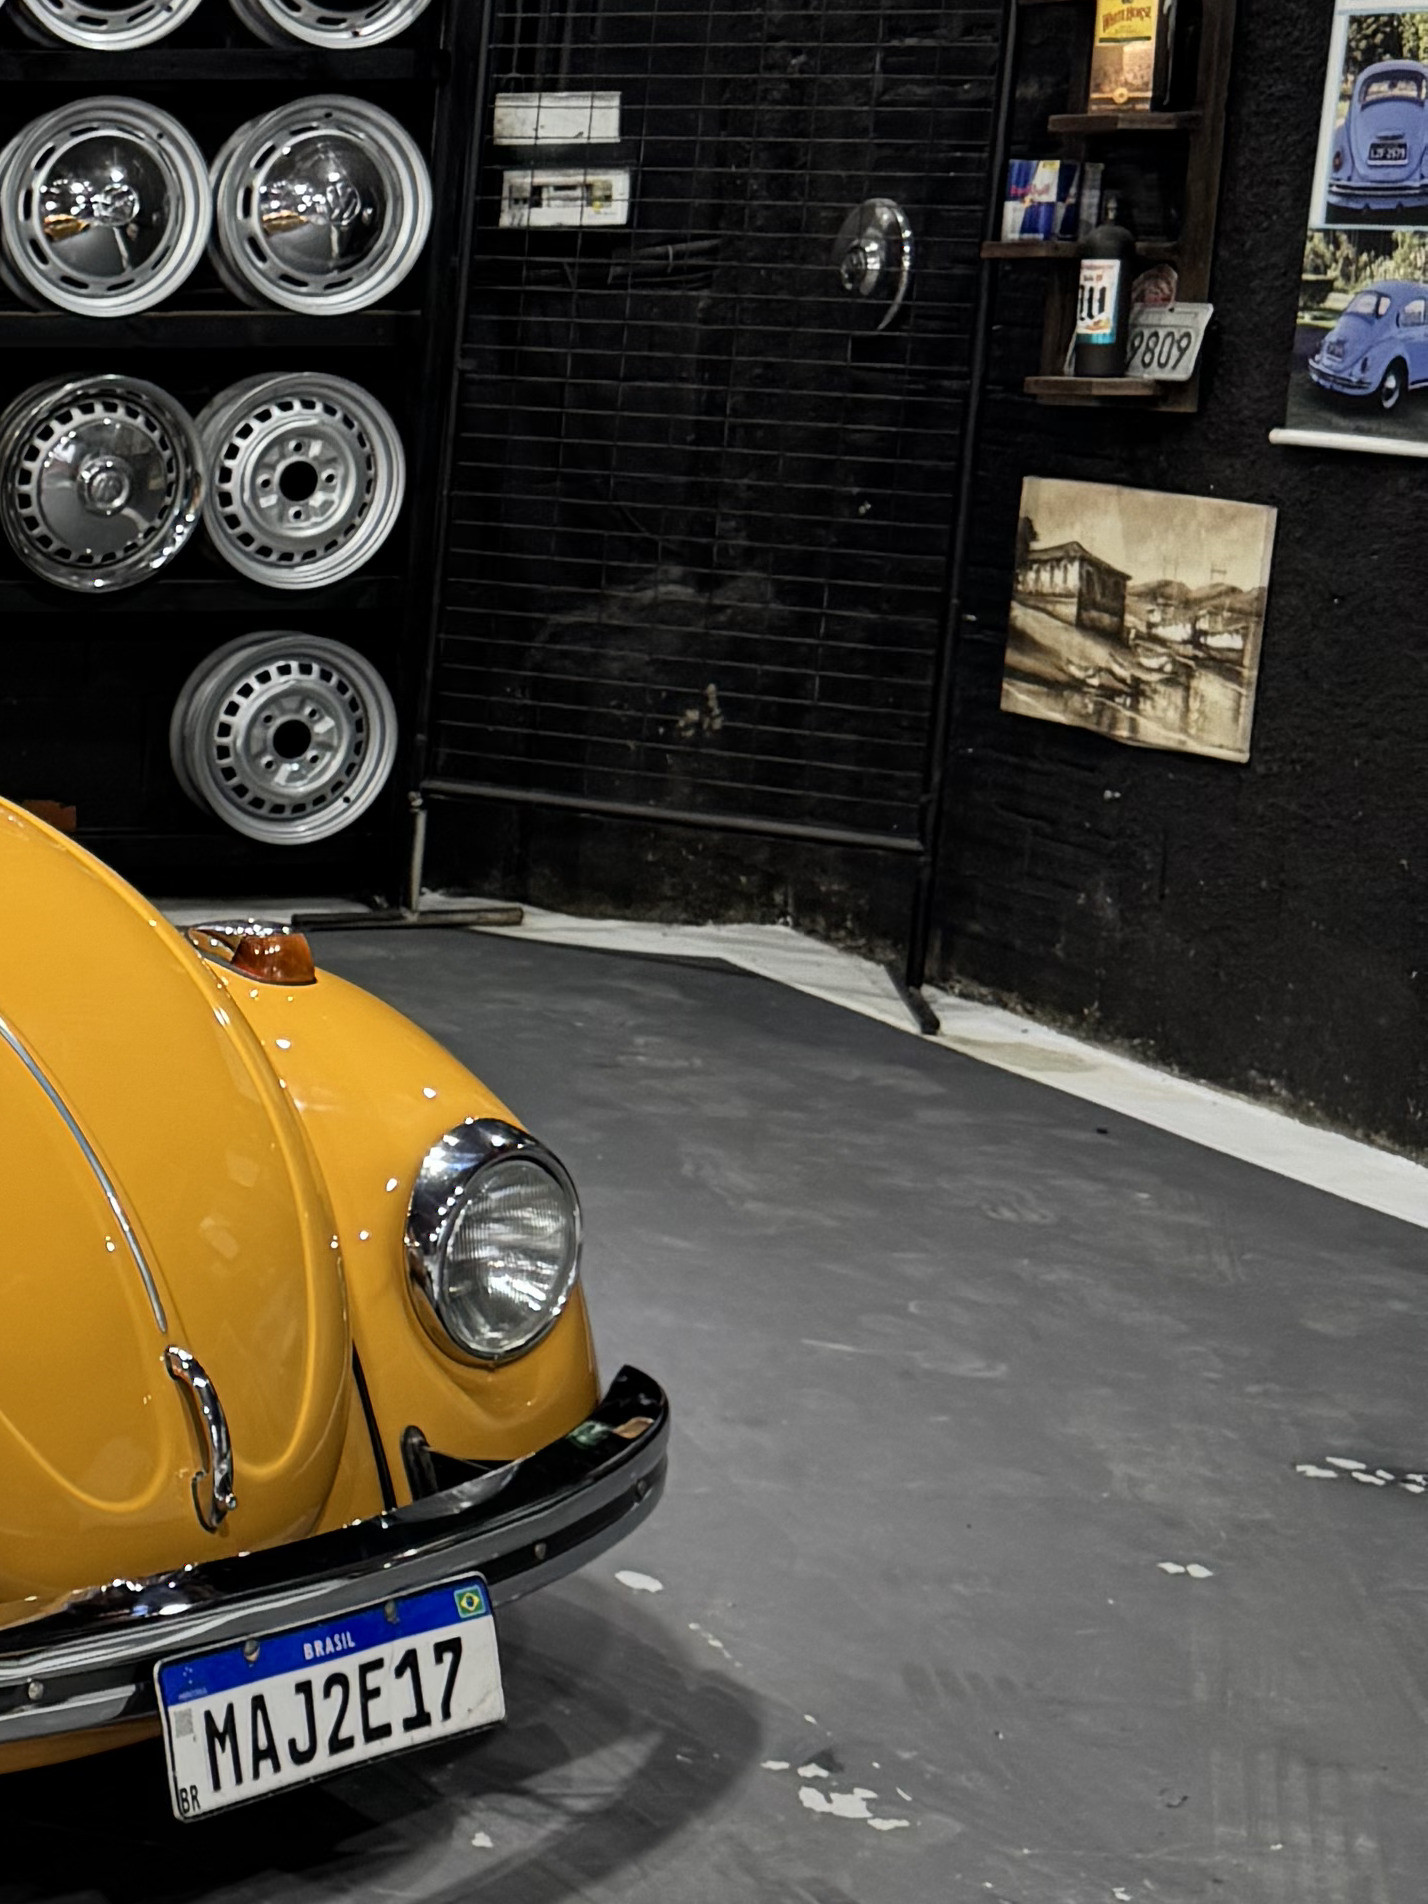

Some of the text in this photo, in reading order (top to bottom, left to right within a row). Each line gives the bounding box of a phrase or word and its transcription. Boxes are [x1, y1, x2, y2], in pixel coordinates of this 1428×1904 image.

[302, 1630, 356, 1661] BRASIL
[203, 1636, 464, 1793] MAJ2E17
[179, 1783, 202, 1814] BR
